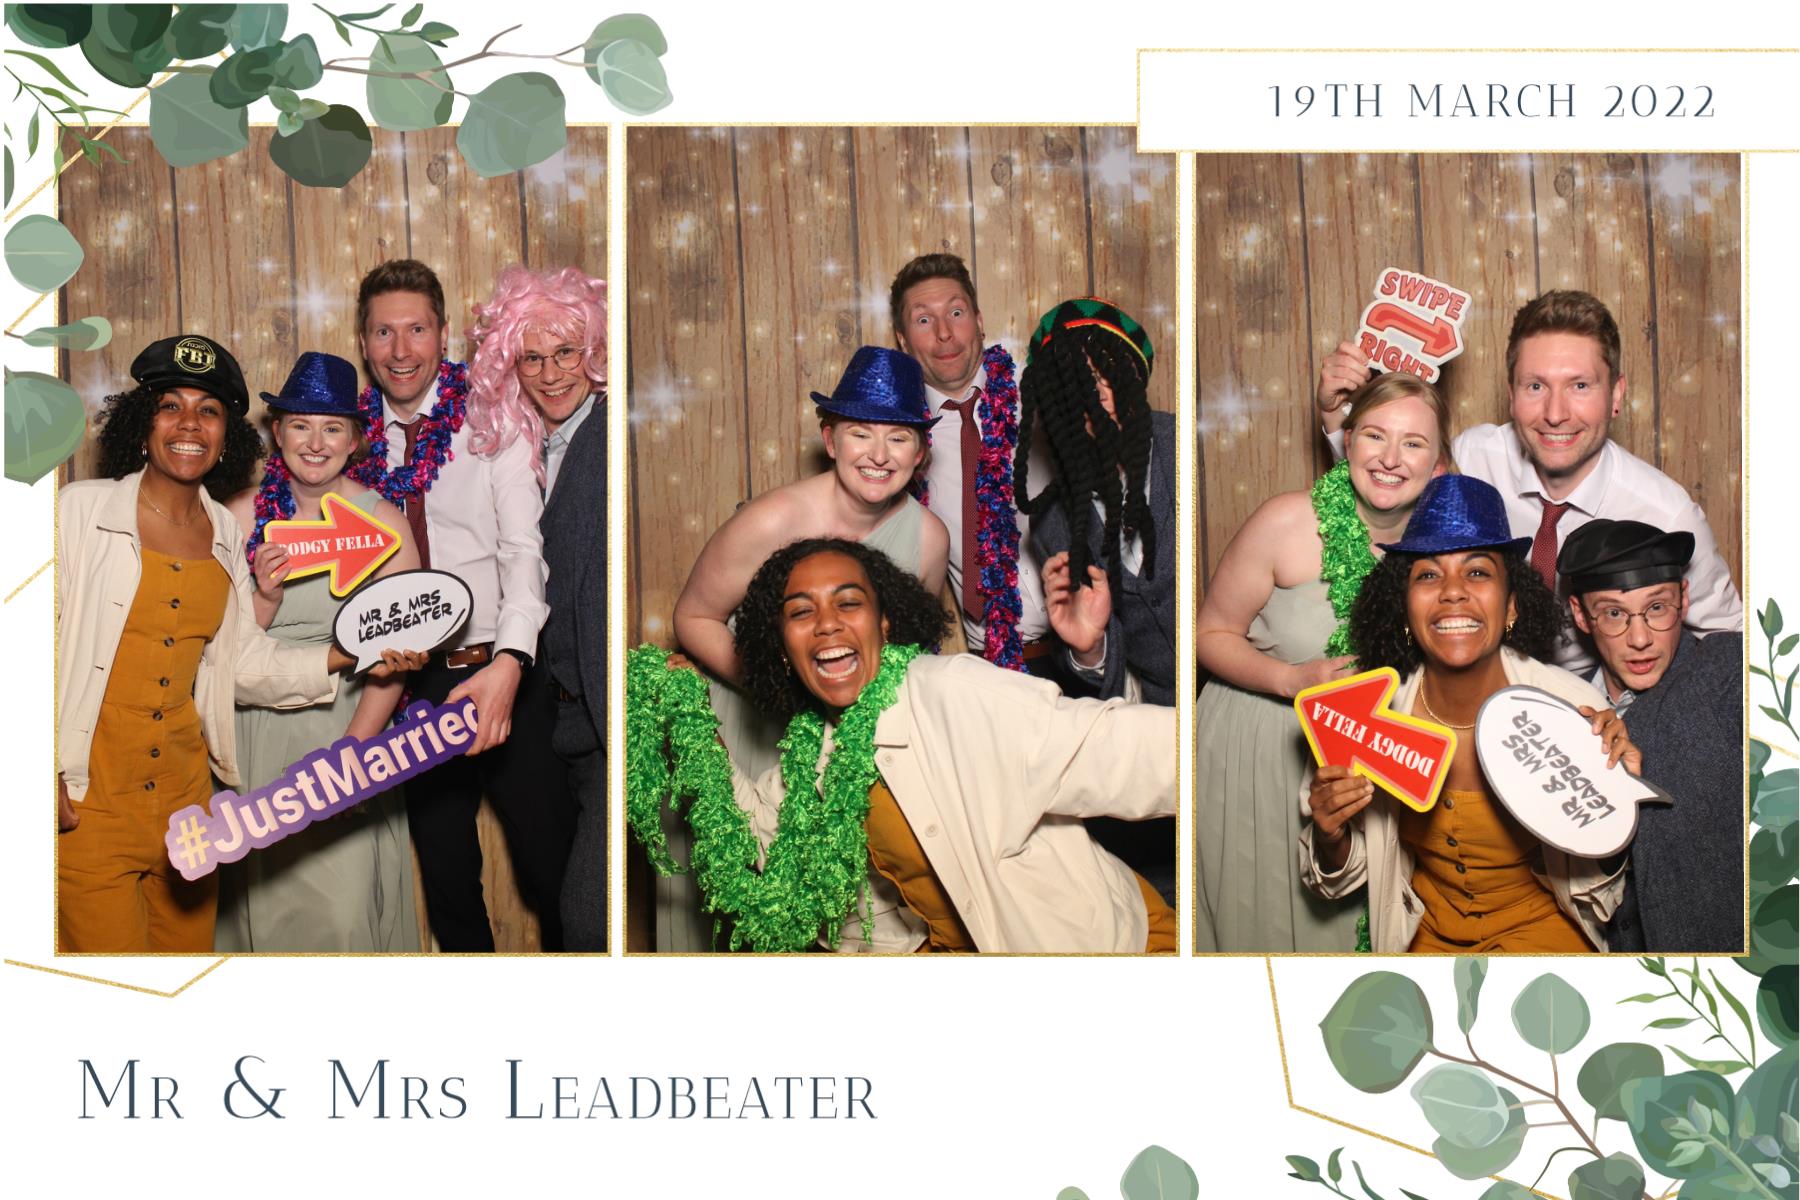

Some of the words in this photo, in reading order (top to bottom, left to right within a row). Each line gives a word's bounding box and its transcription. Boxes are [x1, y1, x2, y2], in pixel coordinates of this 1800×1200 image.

[1380, 271, 1466, 320] SWIPE
[176, 346, 212, 366] FBI
[335, 533, 385, 552] FELLA
[358, 603, 453, 643] LEADBEATER
[359, 608, 382, 627] MR
[389, 602, 402, 618] &
[409, 590, 441, 611] MRS
[1312, 701, 1368, 744] FELLA
[1368, 731, 1436, 778] DODGY
[1502, 735, 1547, 775] MRS
[1512, 710, 1616, 820] LEADBEATER
[1542, 775, 1567, 794] &
[1561, 795, 1597, 829] MR
